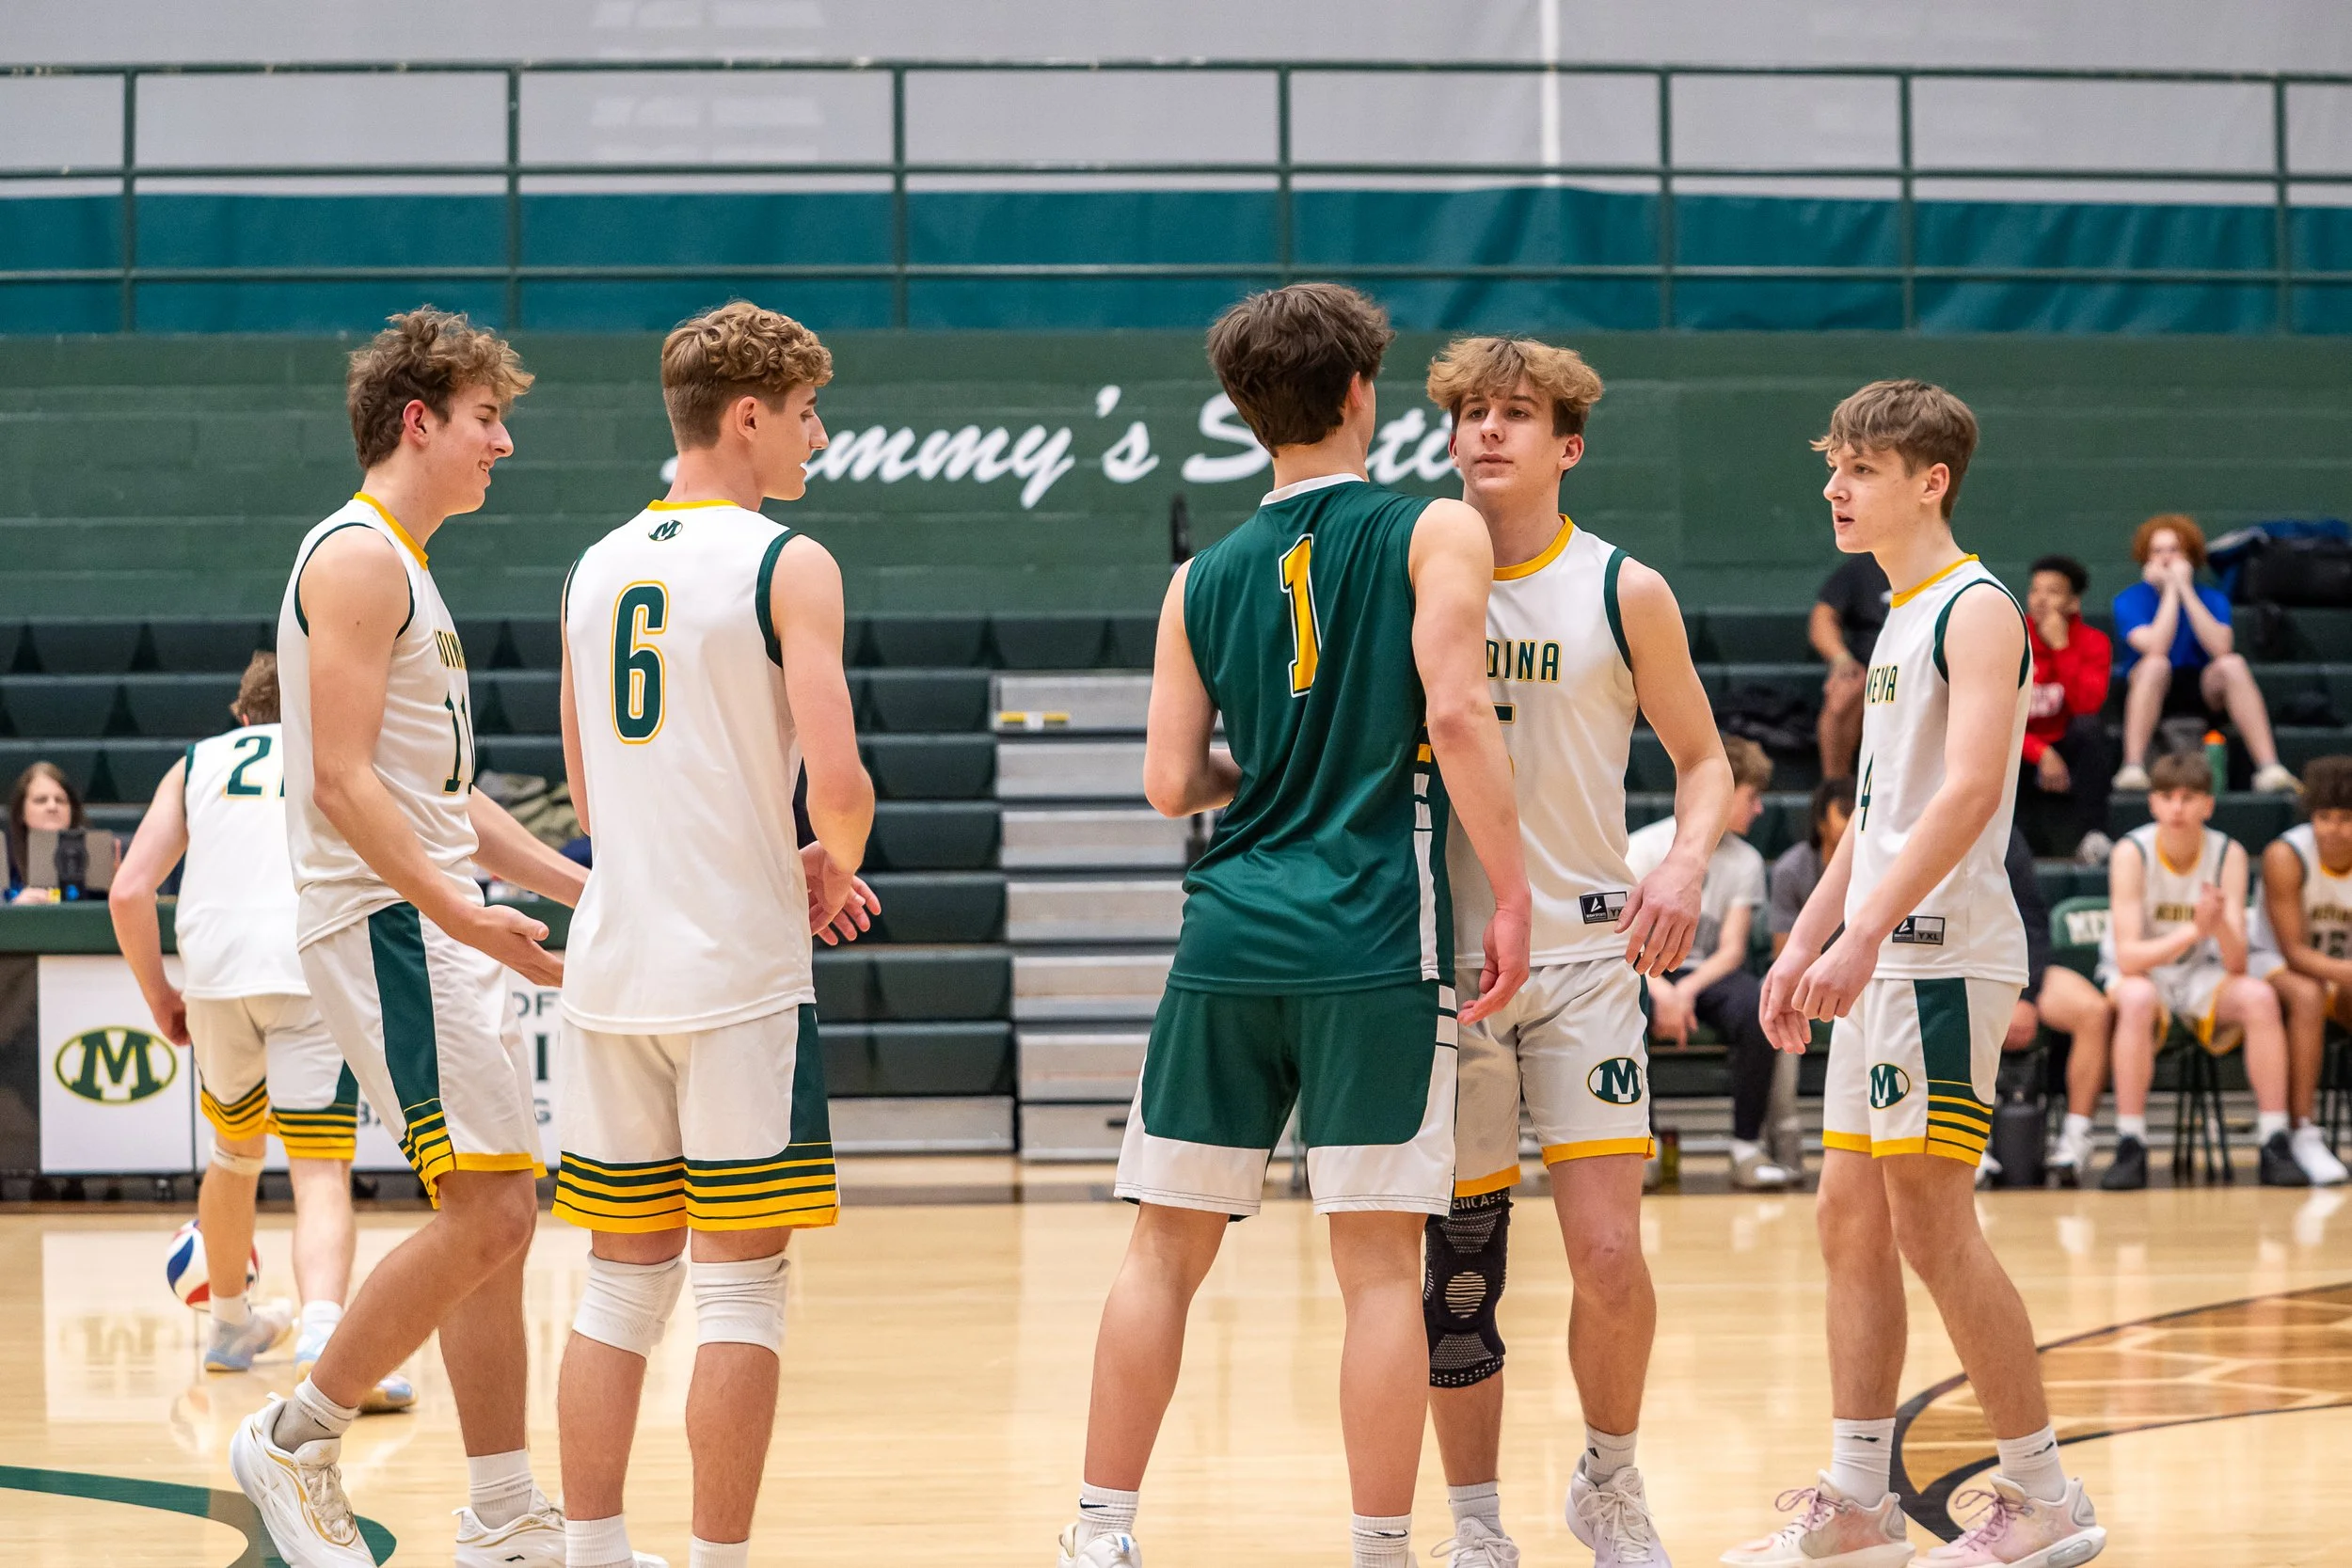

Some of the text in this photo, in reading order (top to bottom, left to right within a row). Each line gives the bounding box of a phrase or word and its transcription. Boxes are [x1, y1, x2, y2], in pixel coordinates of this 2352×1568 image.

[660, 386, 1161, 510] mmy's
[648, 519, 683, 542] M
[1279, 532, 1321, 699] 1
[609, 579, 669, 745] 6
[1486, 639, 1564, 684] DINA
[224, 735, 285, 800] 2
[66, 1029, 166, 1101] M
[1592, 1058, 1643, 1103] M
[1869, 1064, 1907, 1108] M
[1453, 1195, 1490, 1210] ENCA
